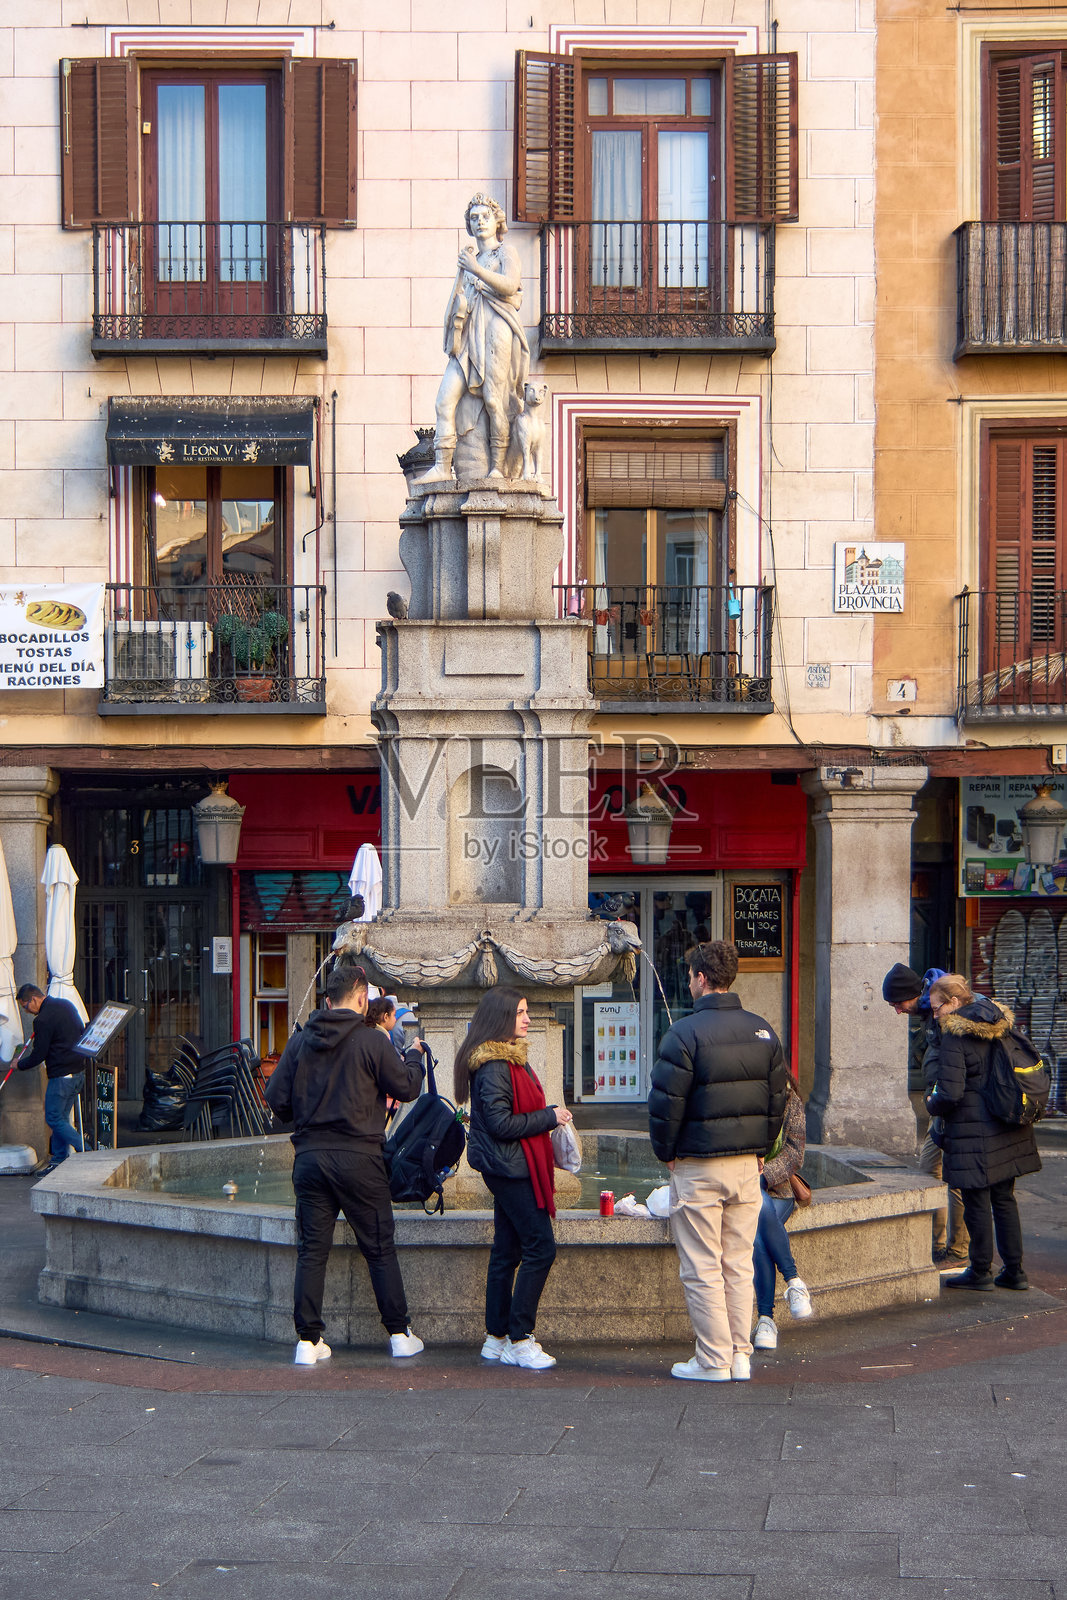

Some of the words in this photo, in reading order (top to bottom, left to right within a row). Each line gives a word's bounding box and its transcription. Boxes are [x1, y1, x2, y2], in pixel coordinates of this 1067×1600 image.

[183, 443, 218, 456] LEÓN
[222, 444, 234, 456] V
[838, 584, 877, 595] PLAZA
[877, 585, 888, 594] DE
[889, 586, 902, 594] LA
[838, 595, 903, 610] PROVINCIA
[0, 632, 90, 643] BOCADILLOS
[16, 647, 73, 658] TOSTAS
[39, 662, 67, 673] DEL
[71, 659, 96, 672] DÍA
[7, 675, 81, 686] RACIONES
[896, 683, 906, 699] 4
[969, 783, 1001, 792] REPAIR
[130, 839, 140, 855] 3
[736, 888, 780, 902] BOCATA
[734, 910, 779, 920] CALAMARES
[736, 939, 768, 948] TERRAZA
